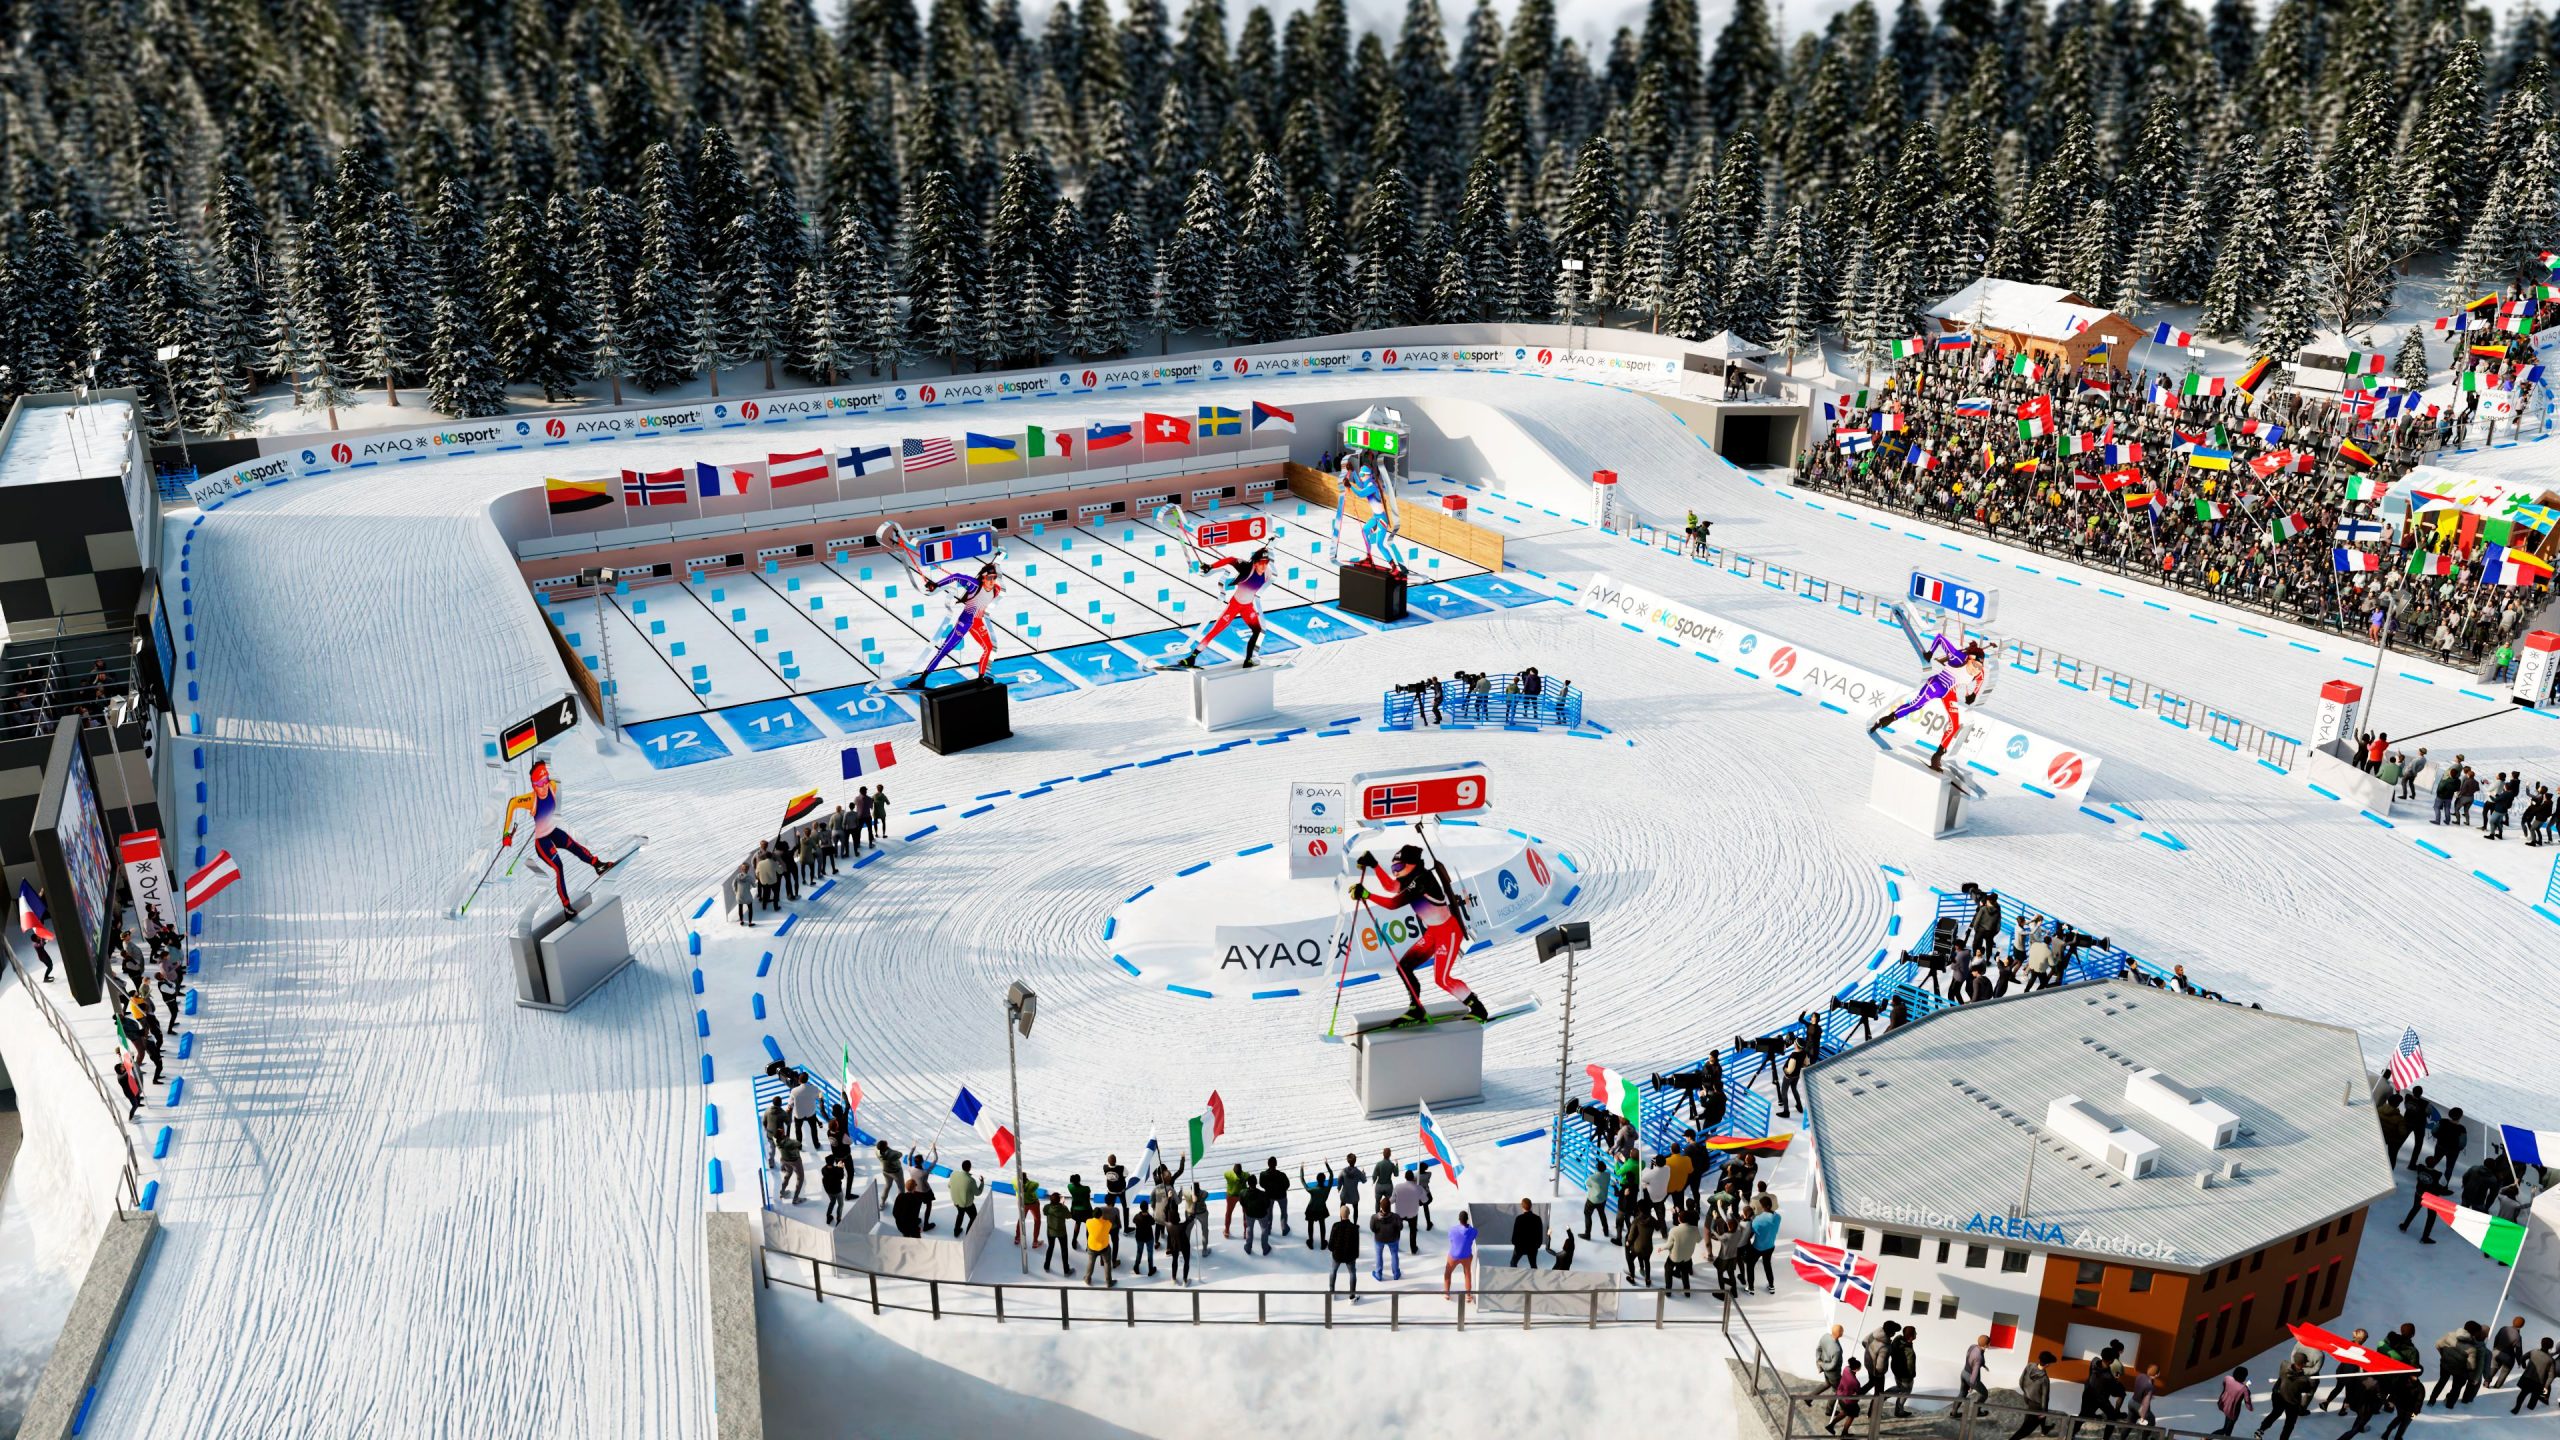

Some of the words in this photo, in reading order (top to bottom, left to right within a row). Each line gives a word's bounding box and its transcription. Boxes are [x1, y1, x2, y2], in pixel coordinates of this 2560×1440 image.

[1255, 358, 1289, 369] AYAQ
[1404, 351, 1438, 361] AYAQ
[1560, 354, 1595, 366] AYAQ
[1105, 371, 1139, 382] AYAQ
[944, 386, 982, 398] AYAQ
[768, 402, 810, 414] AYAQ
[576, 419, 621, 433] AYAQ
[363, 438, 412, 455] AYAQ
[1384, 435, 1394, 449] 5
[194, 485, 225, 504] AYAQ
[1249, 520, 1263, 537] 6
[978, 534, 987, 551] 1
[1428, 595, 1458, 606] 2
[1587, 585, 1635, 614] AYAQ
[1955, 589, 1979, 617] 12
[1307, 617, 1331, 630] 4
[1088, 654, 1113, 670] 7
[1803, 667, 1866, 704] AYAQ
[2520, 662, 2539, 698] AYAQ
[559, 701, 574, 725] 4
[837, 697, 886, 718] 10
[748, 711, 795, 733] 11
[2317, 714, 2335, 746] YAQ
[647, 730, 702, 752] 12
[1456, 780, 1478, 806] 9
[1220, 939, 1322, 970] AYAQ
[1859, 1196, 1958, 1229] Biathlon
[1965, 1212, 2066, 1246] ARENA
[2073, 1228, 2178, 1261] Antholz
